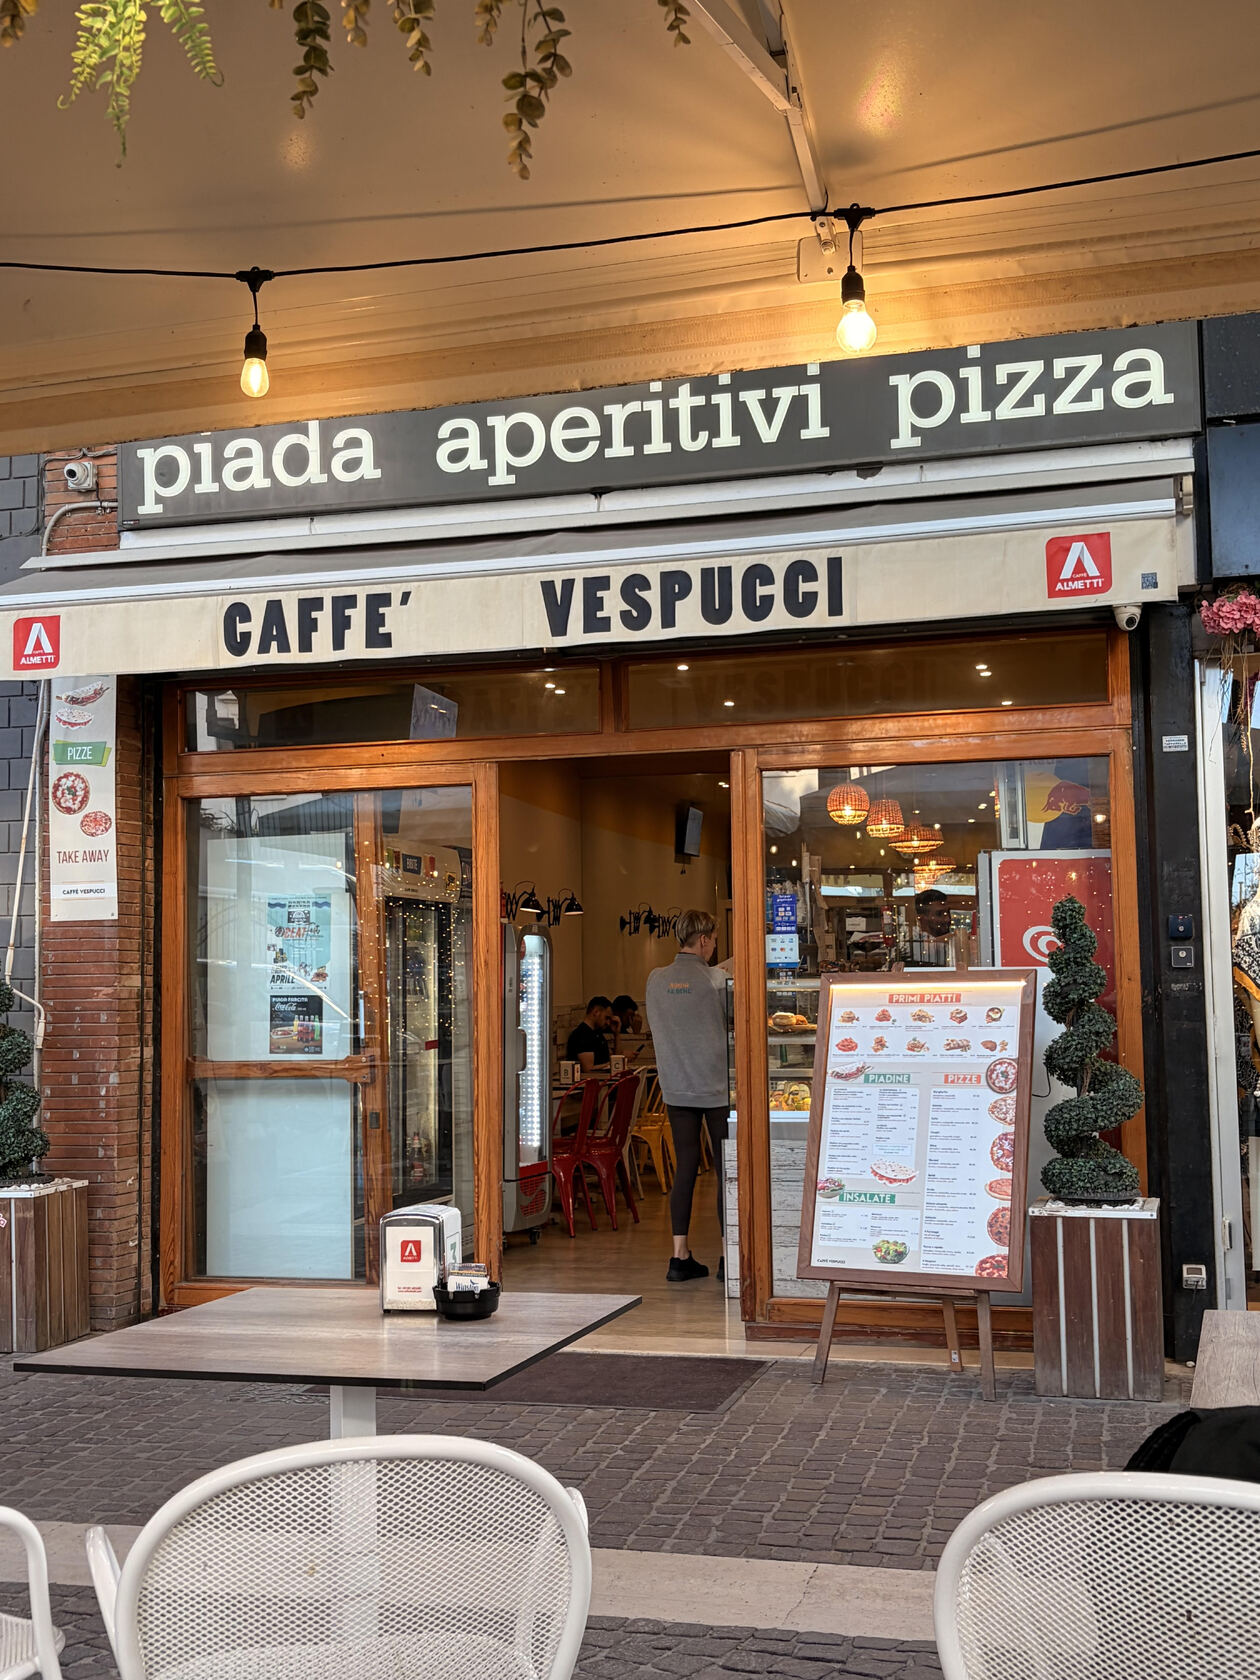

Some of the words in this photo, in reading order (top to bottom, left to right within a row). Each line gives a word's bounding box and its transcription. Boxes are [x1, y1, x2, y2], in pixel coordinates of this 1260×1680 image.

[137, 420, 382, 514] piada
[436, 363, 830, 486] aperitivi
[889, 345, 1174, 449] pizza
[1055, 578, 1103, 591] ALMETTI
[540, 556, 844, 637] VESPUCCI
[20, 655, 55, 664] ALMETTI
[67, 746, 93, 760] PIZZE
[57, 850, 80, 864] TAKE
[82, 849, 109, 863] AWAY
[892, 994, 920, 1003] PRIMI
[924, 993, 956, 1002] PIATTI
[869, 1074, 910, 1083] PIADINE
[948, 1074, 978, 1083] PIZZE
[843, 1192, 891, 1203] INSALATE
